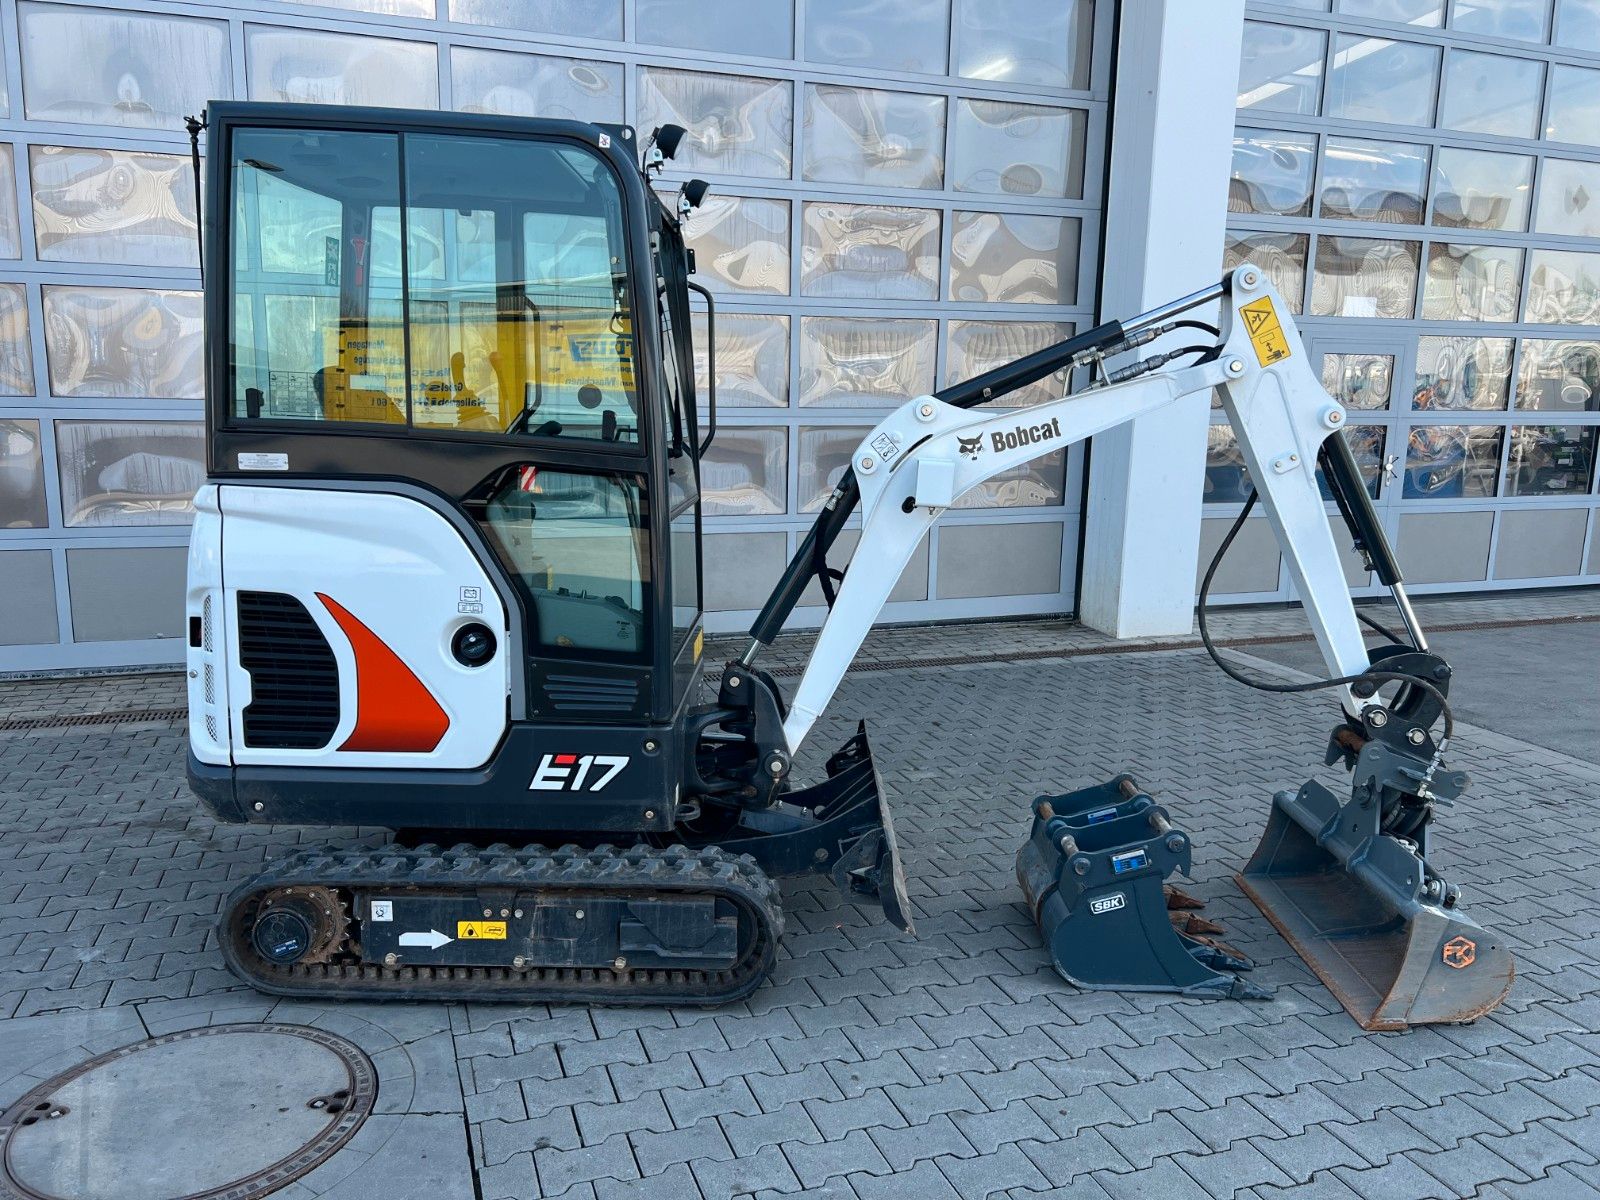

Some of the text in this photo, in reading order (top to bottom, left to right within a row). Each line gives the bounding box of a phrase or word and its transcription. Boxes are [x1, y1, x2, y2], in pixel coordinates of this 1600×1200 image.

[991, 417, 1062, 453] Bobcat
[529, 754, 630, 791] E17
[1094, 898, 1120, 911] SBK
